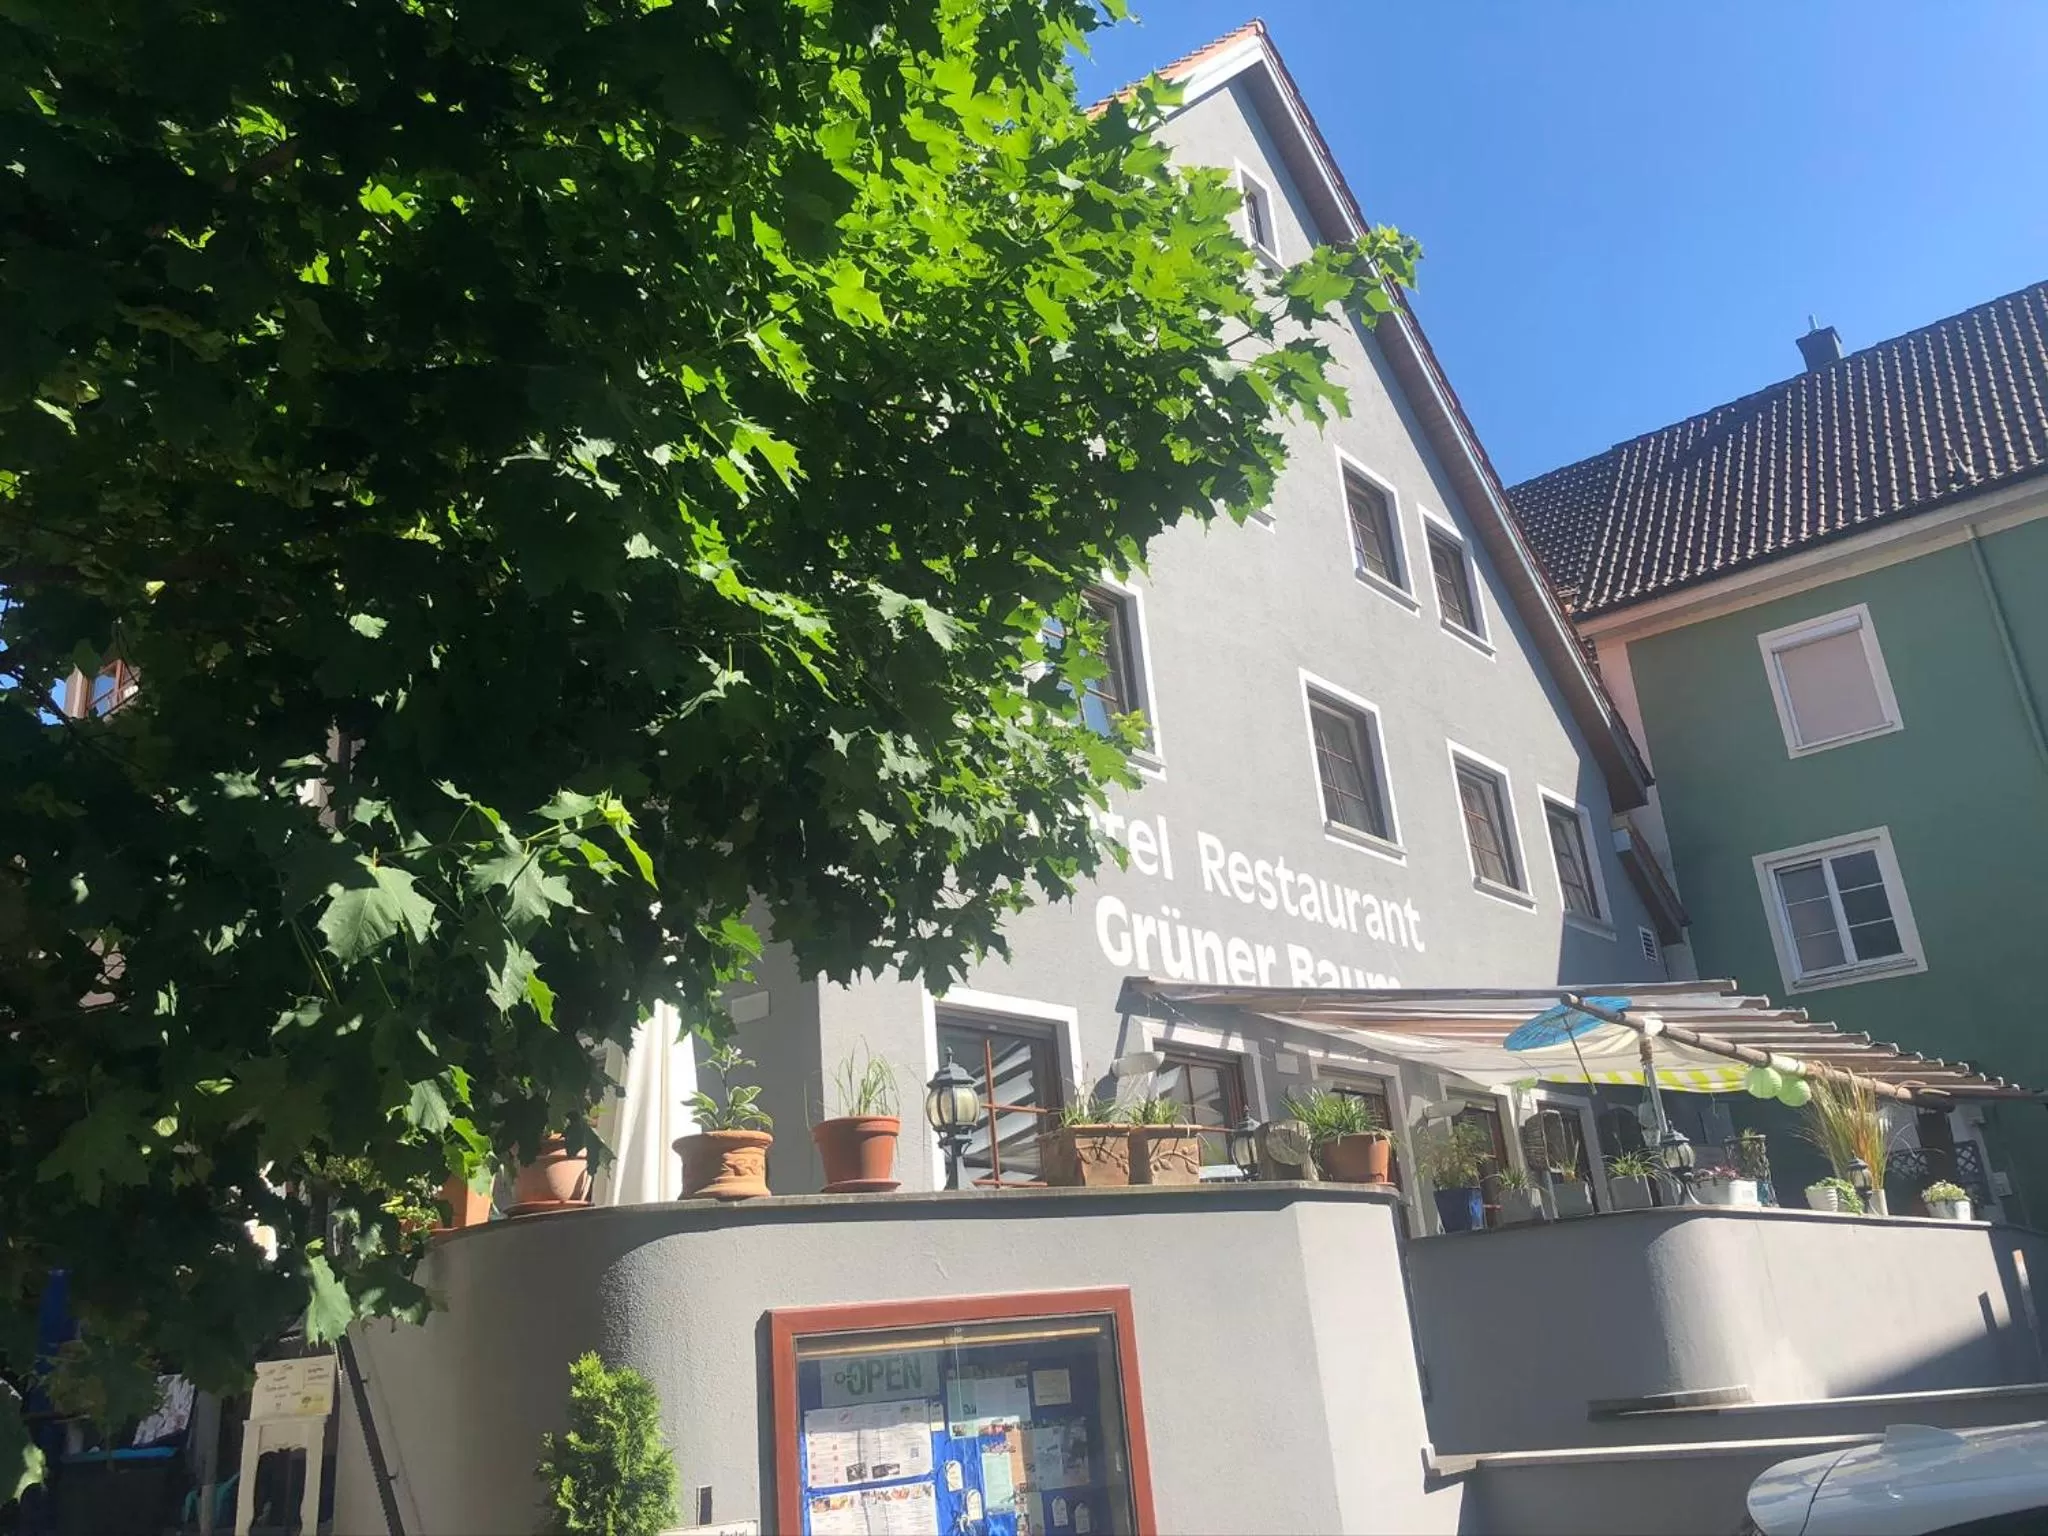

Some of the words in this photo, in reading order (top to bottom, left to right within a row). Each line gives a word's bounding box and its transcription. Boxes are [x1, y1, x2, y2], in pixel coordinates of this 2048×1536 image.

[1074, 798, 1174, 881] tel
[1197, 830, 1426, 953] Restaurant
[1095, 895, 1277, 986] Grüner
[845, 1355, 922, 1396] OPEN
